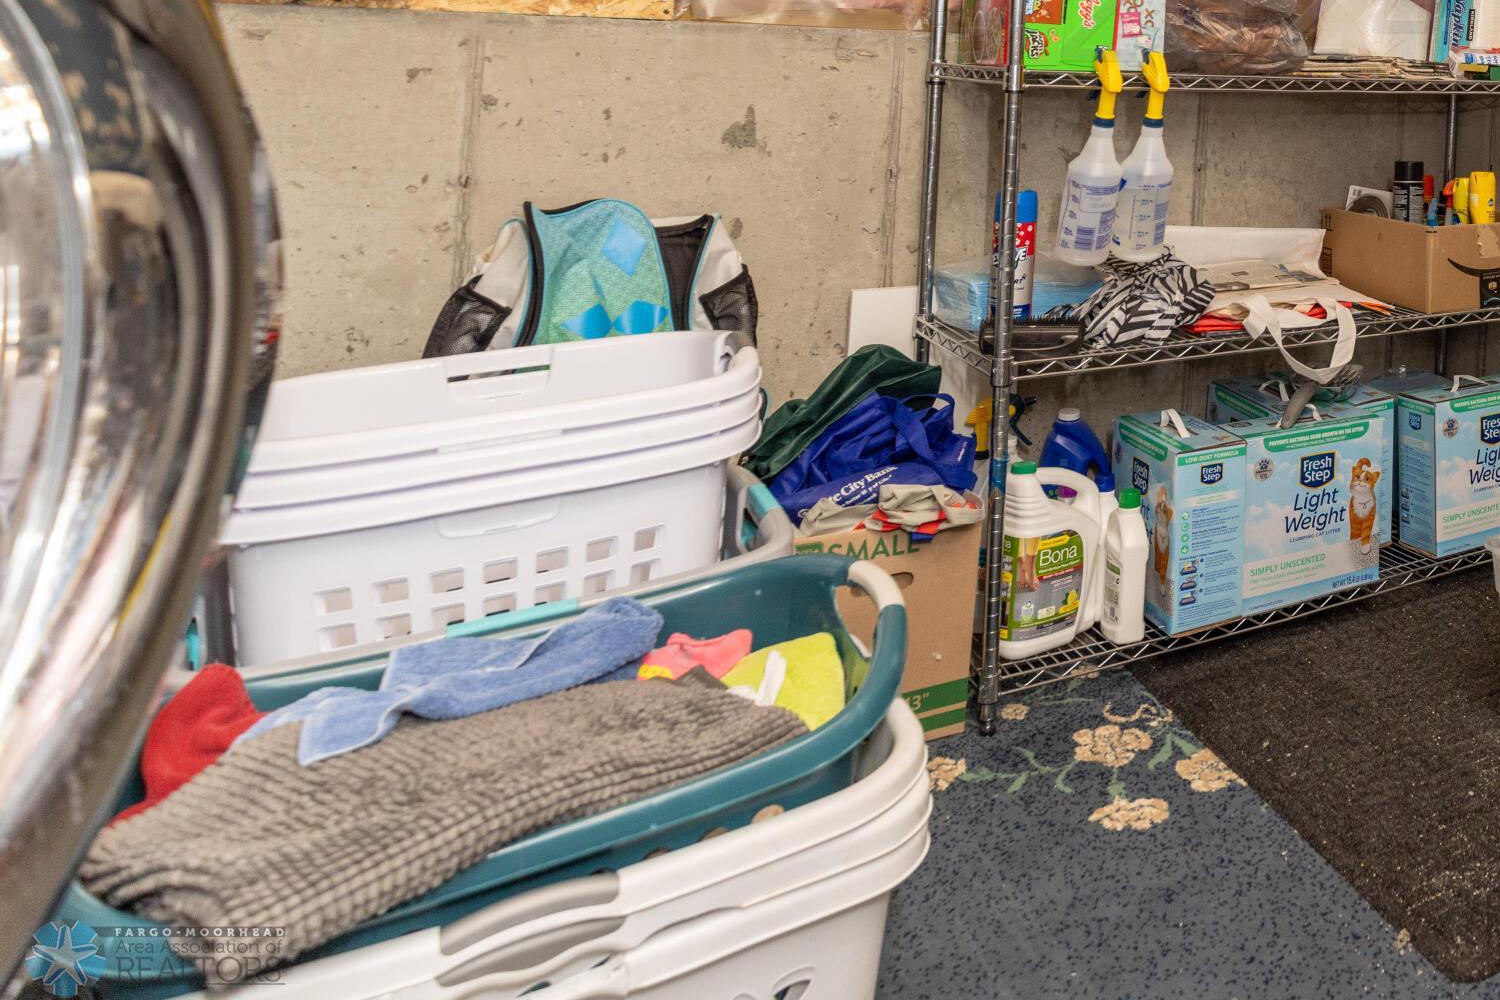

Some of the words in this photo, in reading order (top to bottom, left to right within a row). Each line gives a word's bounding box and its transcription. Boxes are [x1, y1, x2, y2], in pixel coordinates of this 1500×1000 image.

[1025, 29, 1039, 58] JACKS
[1185, 454, 1213, 463] LOW-DUST
[1213, 451, 1239, 459] FORMULA
[1303, 455, 1332, 471] Fresh
[1202, 464, 1222, 475] Fresh
[1203, 472, 1221, 482] Step
[1304, 470, 1331, 483] Step
[841, 478, 865, 496] City
[866, 466, 898, 482] Bank
[1293, 488, 1339, 512] Light
[1284, 507, 1347, 534] Weight
[1443, 512, 1466, 523] SIMPLY
[828, 532, 920, 560] SMALL
[1289, 533, 1315, 543] CLUMPING
[1039, 546, 1077, 566] Bona
[1249, 564, 1279, 577] SIMPLY
[1280, 553, 1326, 570] UNSCENTED
